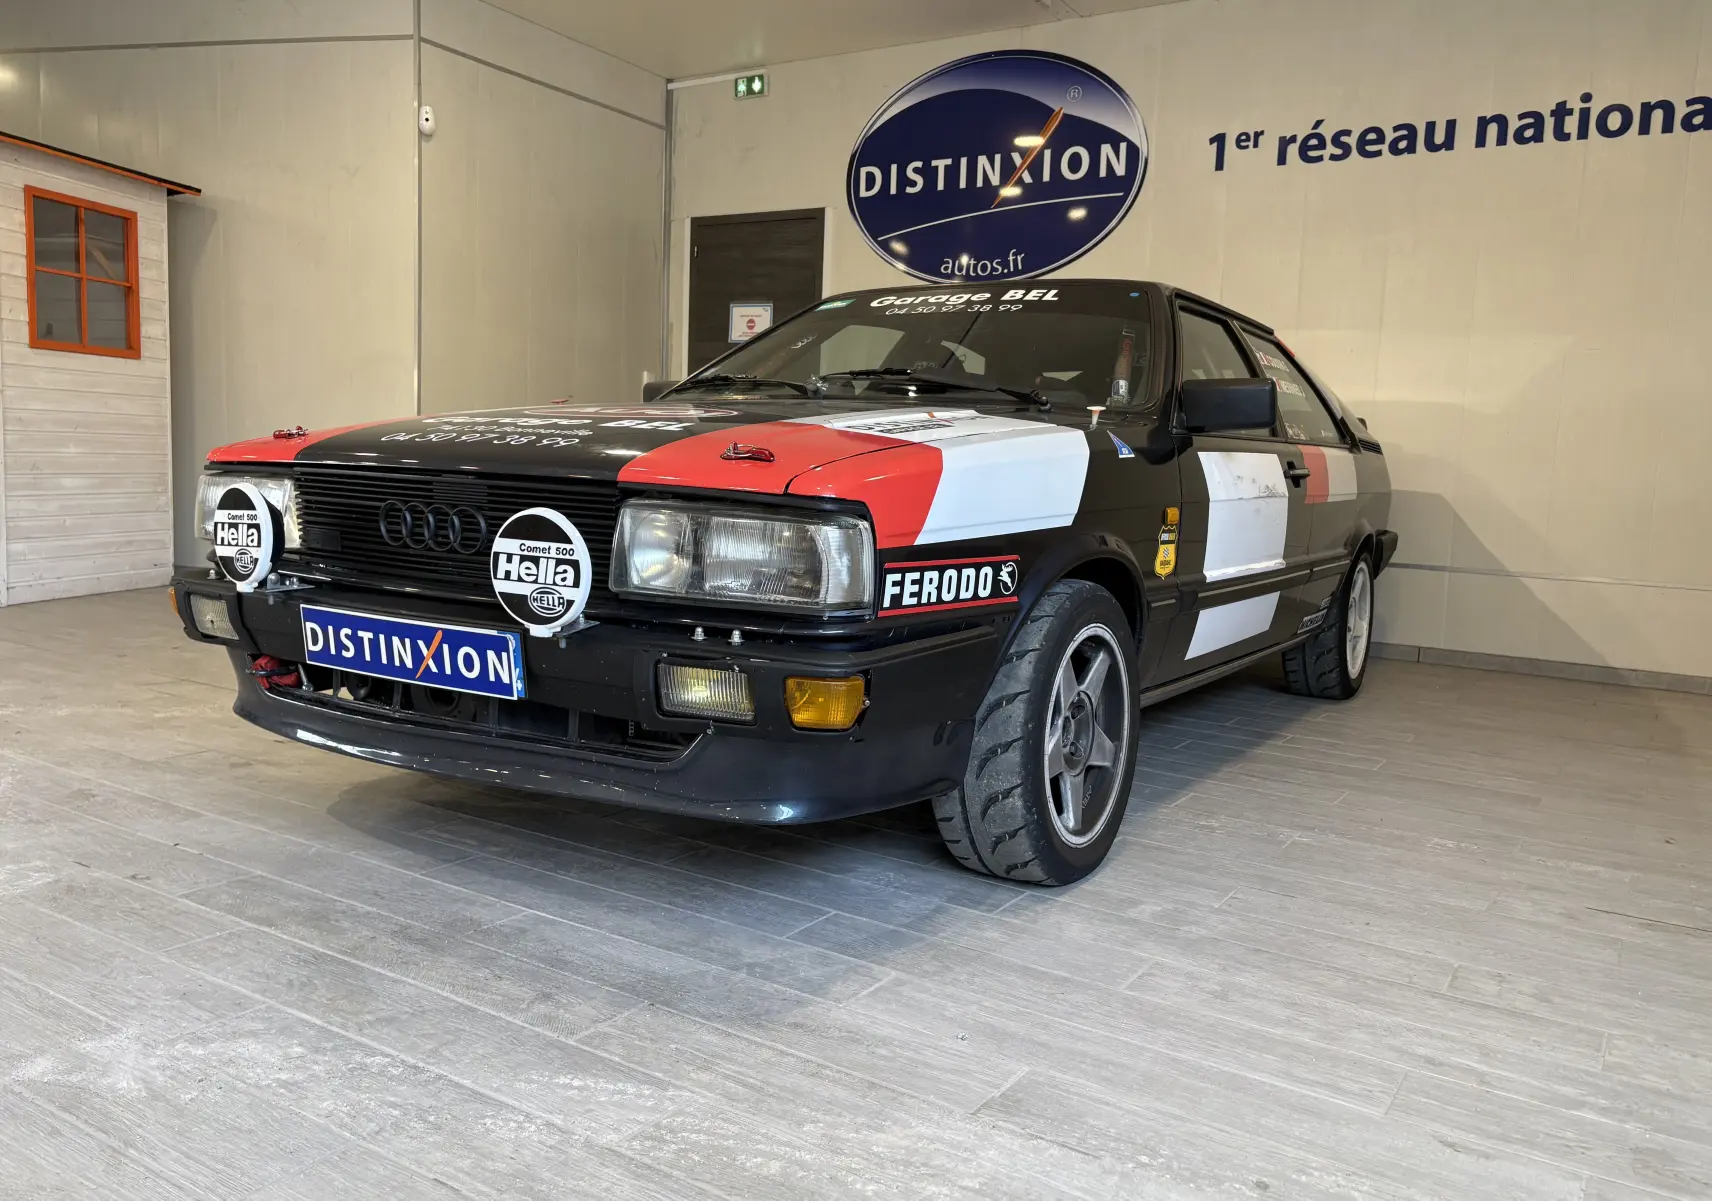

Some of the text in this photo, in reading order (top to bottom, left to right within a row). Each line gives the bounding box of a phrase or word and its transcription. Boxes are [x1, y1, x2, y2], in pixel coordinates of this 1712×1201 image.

[1208, 127, 1265, 172] 1er
[1275, 118, 1457, 167] réseau
[859, 138, 1128, 200] DISTINXION
[940, 249, 1025, 276] autos.fr
[869, 292, 992, 307] Garage
[1000, 289, 1060, 301] BEL
[885, 304, 1023, 316] 04 50 97 38 99
[597, 419, 697, 431] BEL
[380, 432, 580, 447] 04 50 97 38 99
[227, 512, 258, 522] Comet 500
[216, 522, 259, 547] Hella
[519, 542, 575, 557] Comet 500
[496, 553, 575, 587] Hella
[882, 565, 994, 609] FERODO
[532, 594, 566, 609] HELLA
[305, 621, 511, 686] DISTINXION
